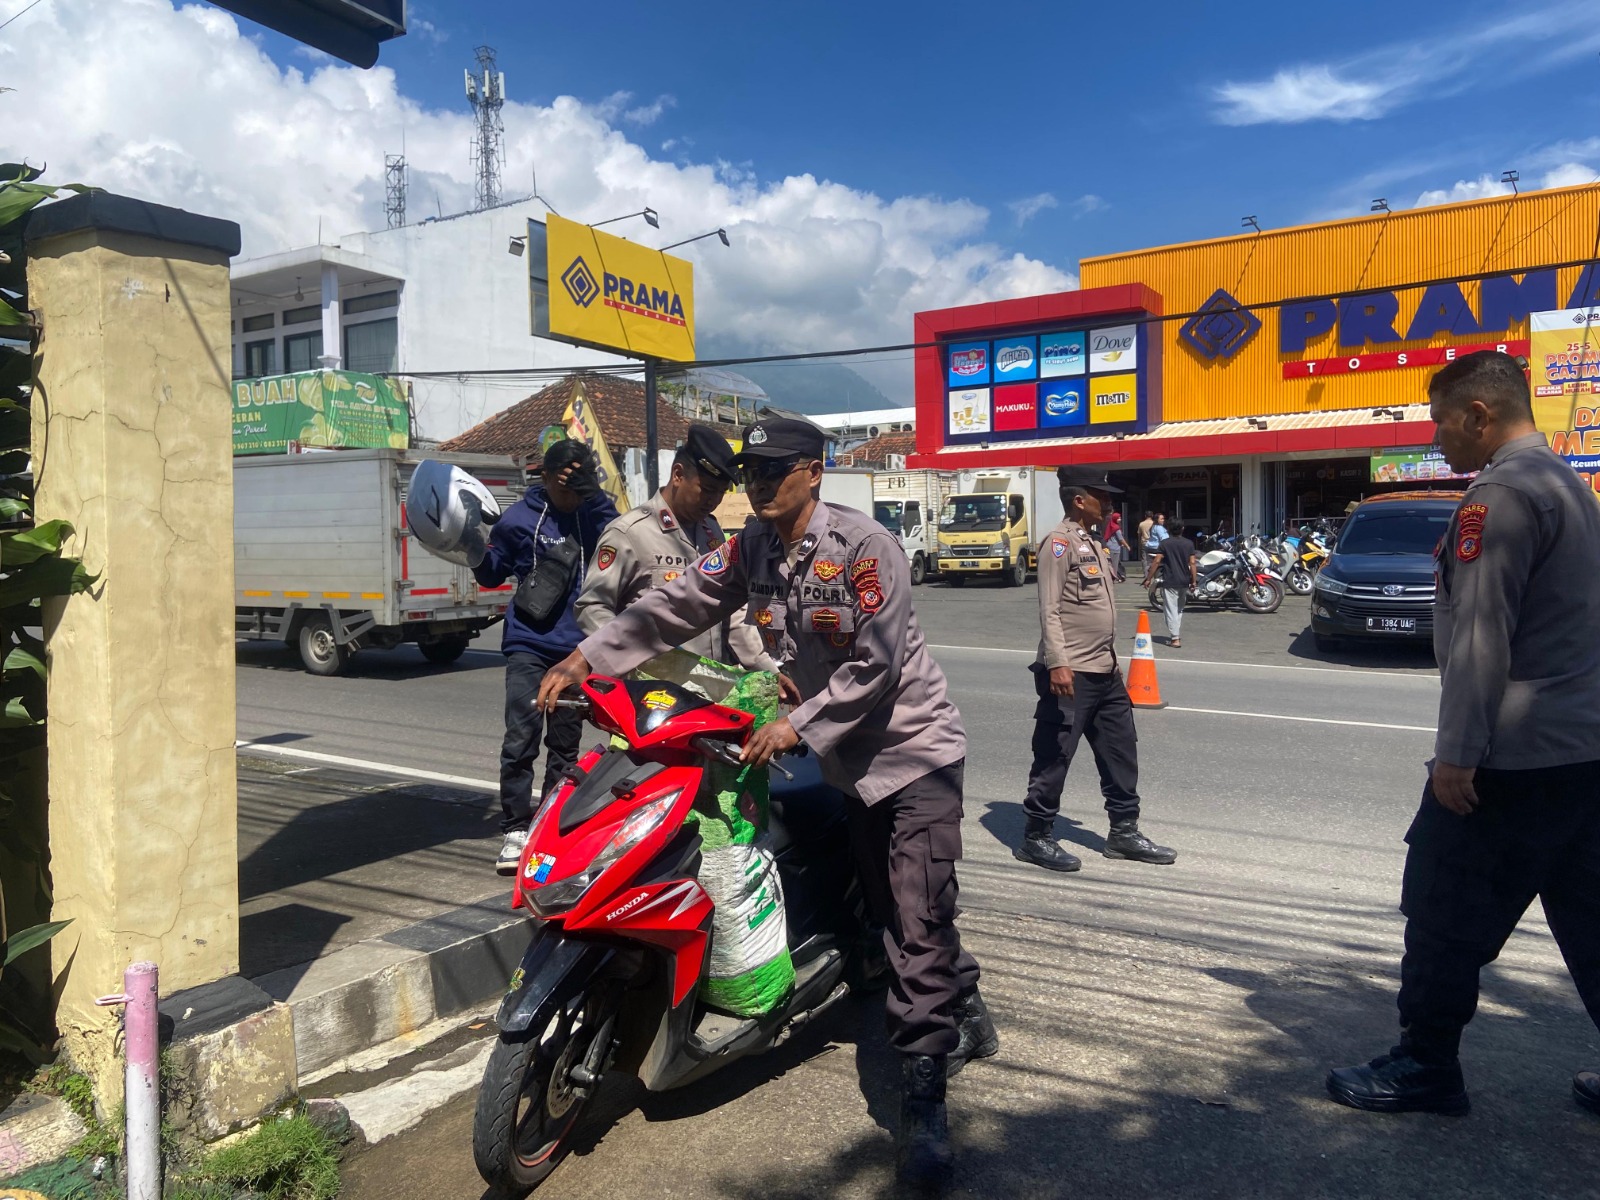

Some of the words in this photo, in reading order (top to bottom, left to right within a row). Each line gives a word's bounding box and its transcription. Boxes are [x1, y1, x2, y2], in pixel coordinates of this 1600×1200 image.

[603, 271, 685, 318] PRAMA
[609, 301, 682, 325] TOSERBA
[1093, 334, 1132, 350] Dove
[1567, 342, 1591, 351] 25-5
[1545, 351, 1600, 367] PROM
[1545, 365, 1600, 381] GAJIA
[237, 378, 298, 408] BUAH
[244, 423, 267, 436] Parcel
[1460, 505, 1486, 517] POLRES
[655, 555, 687, 566] YOPI
[803, 586, 846, 602] POLRI
[1368, 618, 1373, 626] D
[606, 891, 649, 922] HONDA
